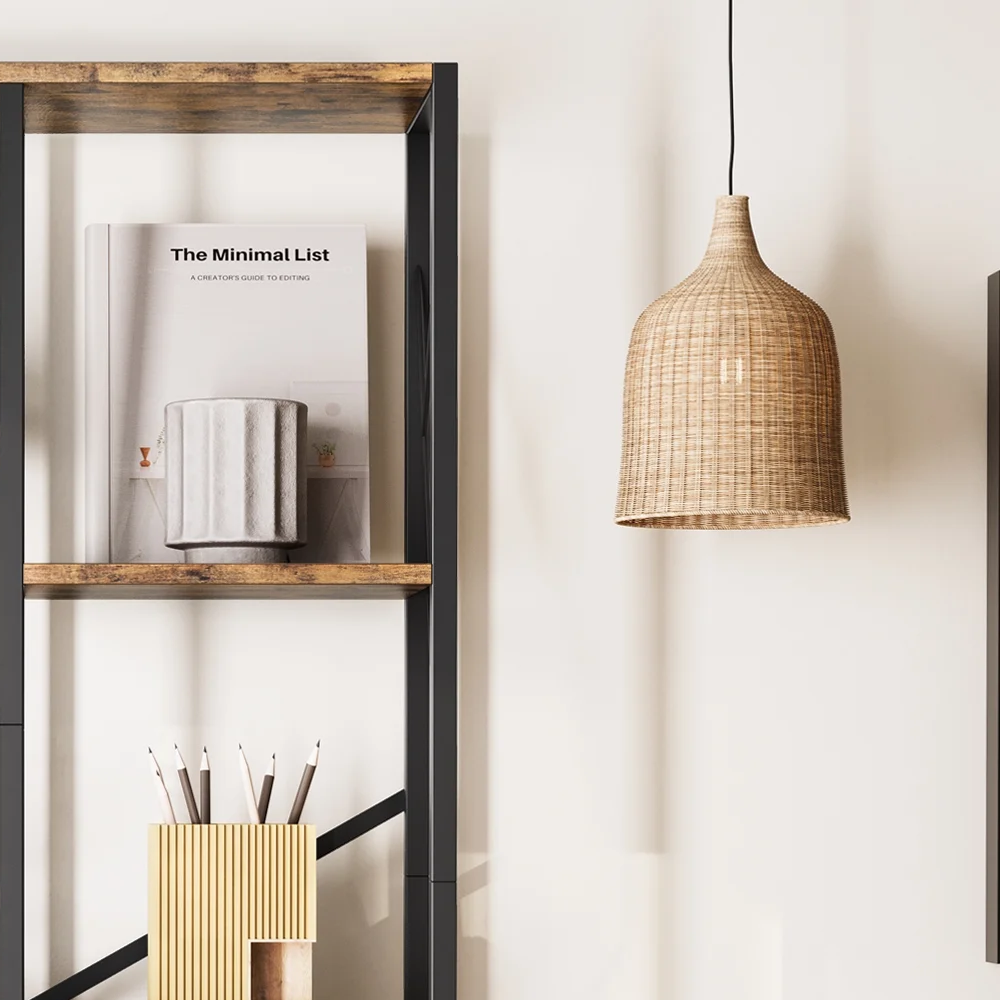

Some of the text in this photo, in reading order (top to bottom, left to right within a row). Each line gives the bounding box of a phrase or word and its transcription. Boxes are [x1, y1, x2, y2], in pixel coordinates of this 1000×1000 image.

[169, 247, 330, 262] The Minimal List
[190, 274, 311, 282] A CREATOR'S GUIDE TO EDITING
